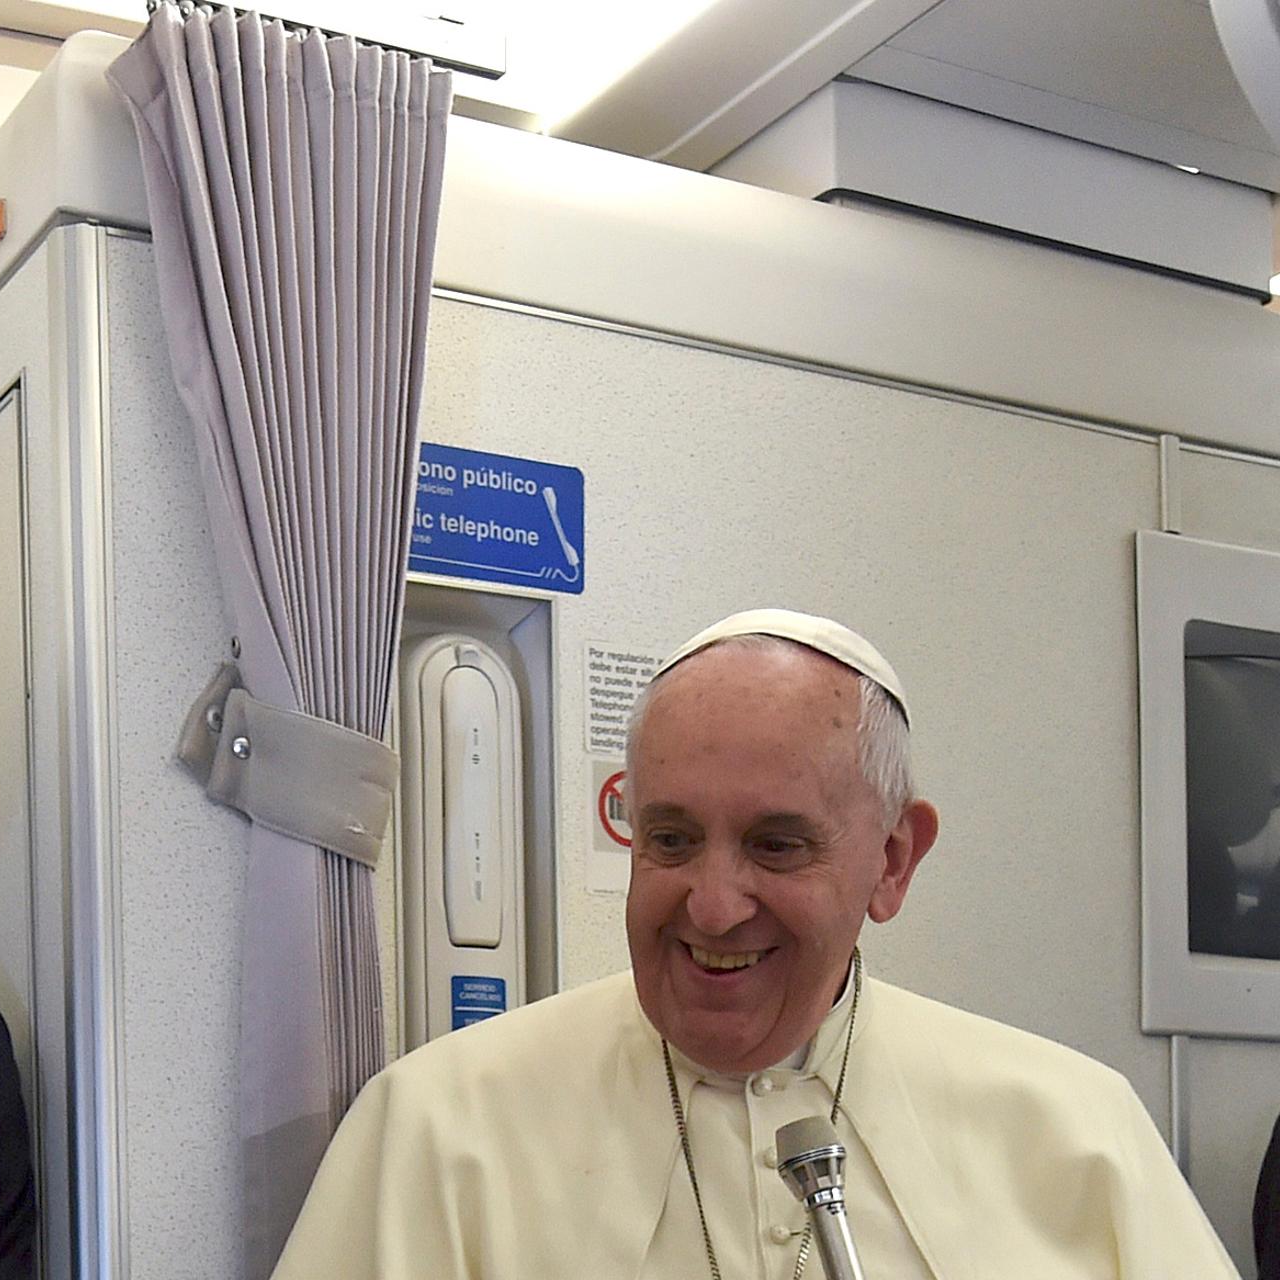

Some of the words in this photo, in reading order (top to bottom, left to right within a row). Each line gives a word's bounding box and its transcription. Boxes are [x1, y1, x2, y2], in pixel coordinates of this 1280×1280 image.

[418, 461, 457, 481] ono
[462, 467, 537, 495] público
[416, 507, 434, 529] ic
[440, 512, 540, 546] telephone
[589, 647, 604, 658] Por
[589, 662, 612, 672] debe
[616, 665, 638, 675] estar
[641, 668, 656, 677] sit
[589, 675, 601, 683] no
[604, 677, 633, 687] puede
[636, 680, 648, 688] se
[590, 698, 634, 711] Telephon
[590, 713, 624, 724] stowed
